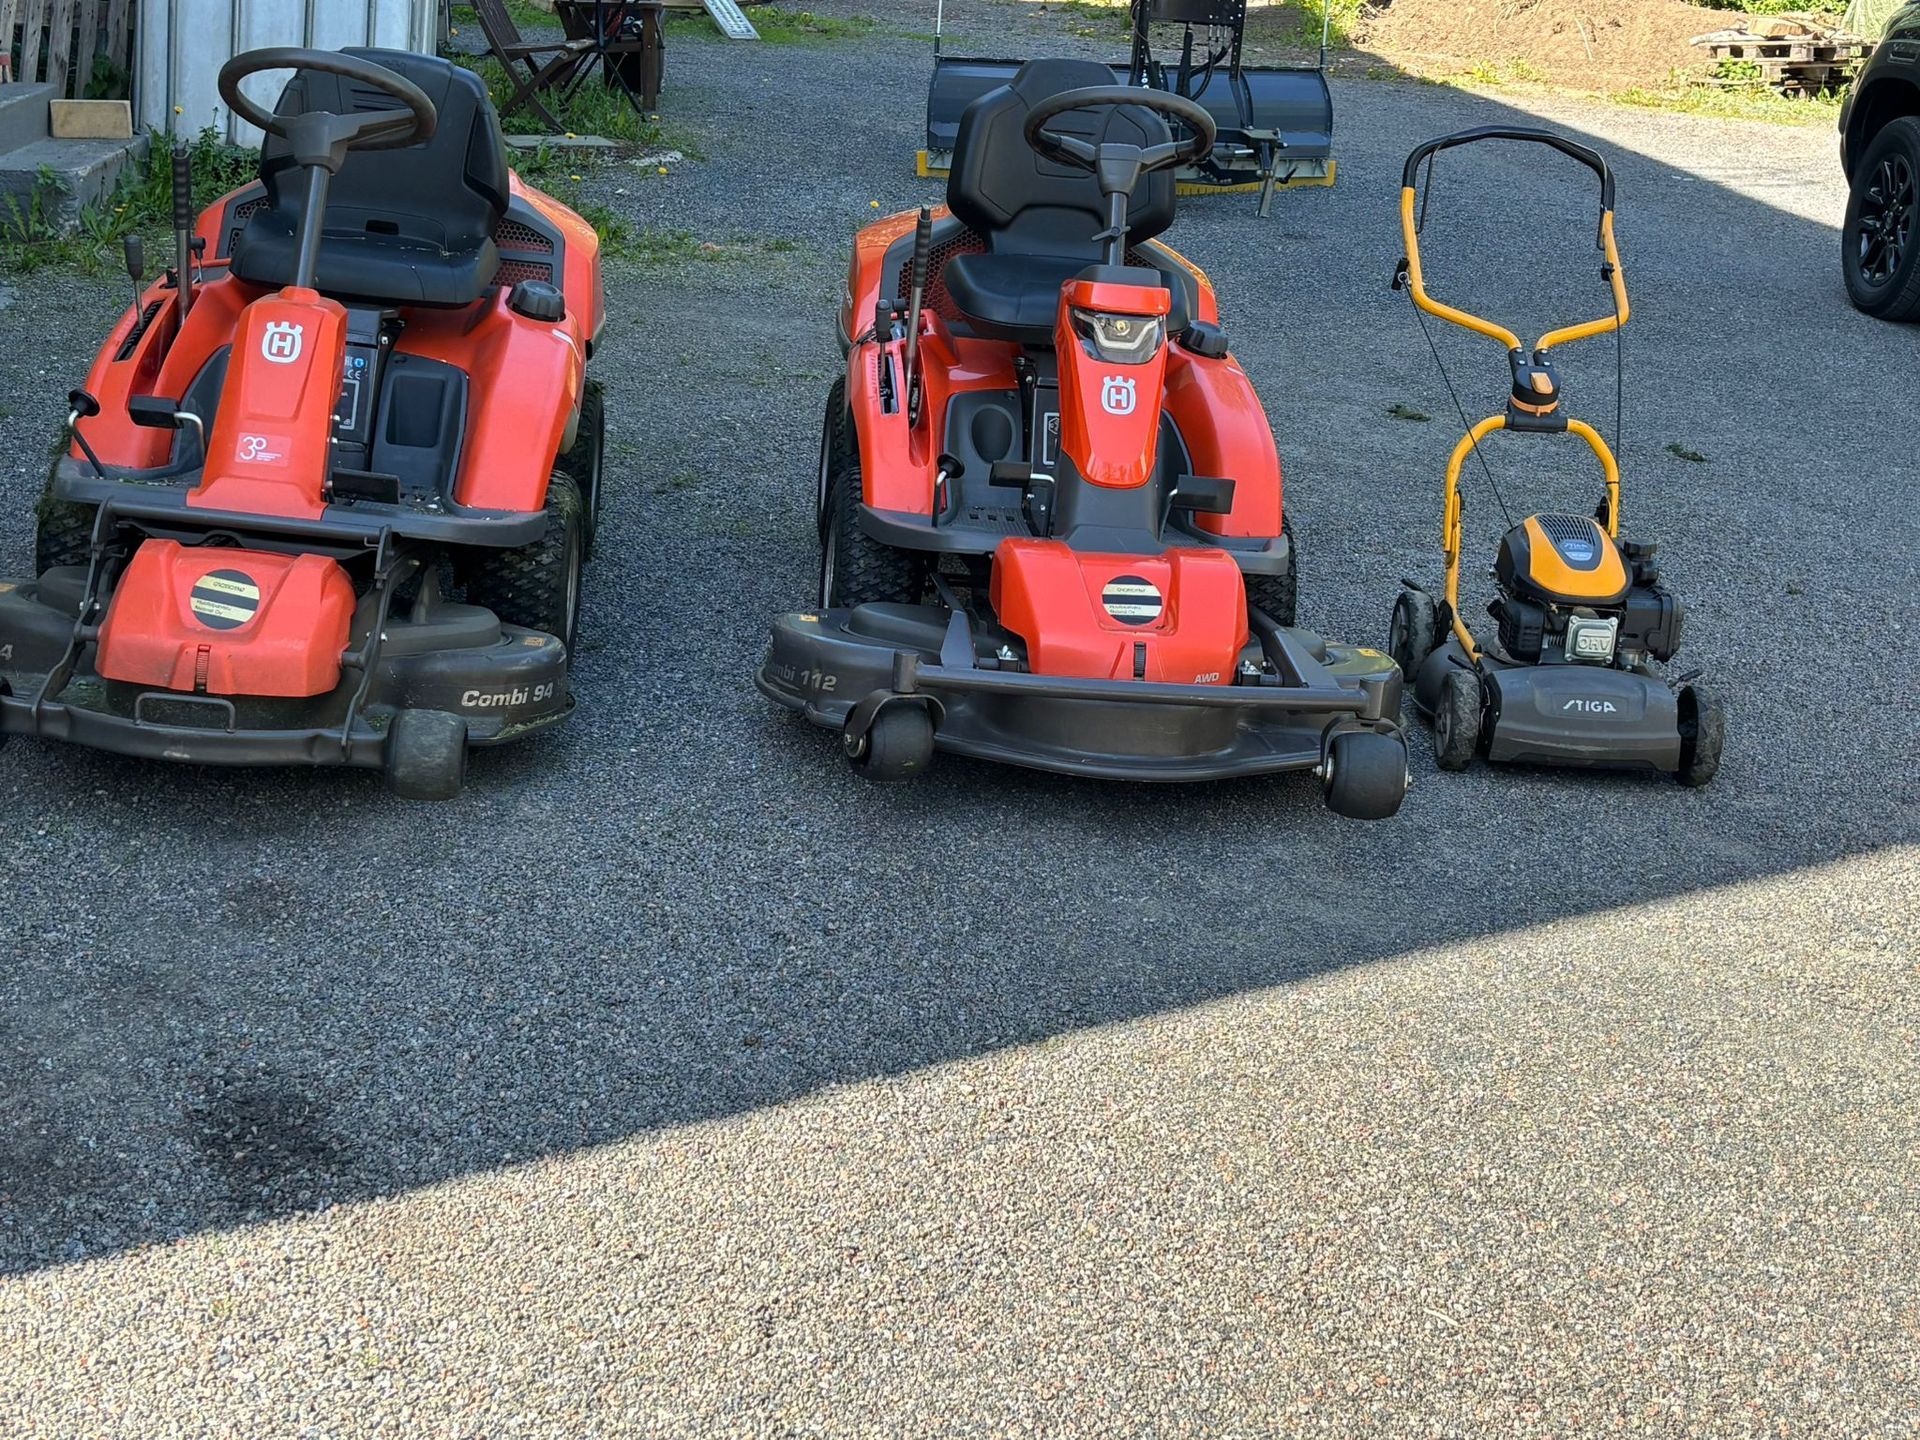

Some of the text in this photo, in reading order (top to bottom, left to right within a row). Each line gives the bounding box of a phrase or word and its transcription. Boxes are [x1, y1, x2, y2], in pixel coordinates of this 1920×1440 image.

[1578, 637, 1611, 651] OHV
[800, 670, 837, 692] 112
[1193, 672, 1220, 684] AWD
[461, 682, 554, 707] Combi 94
[1563, 699, 1617, 713] STIGA
